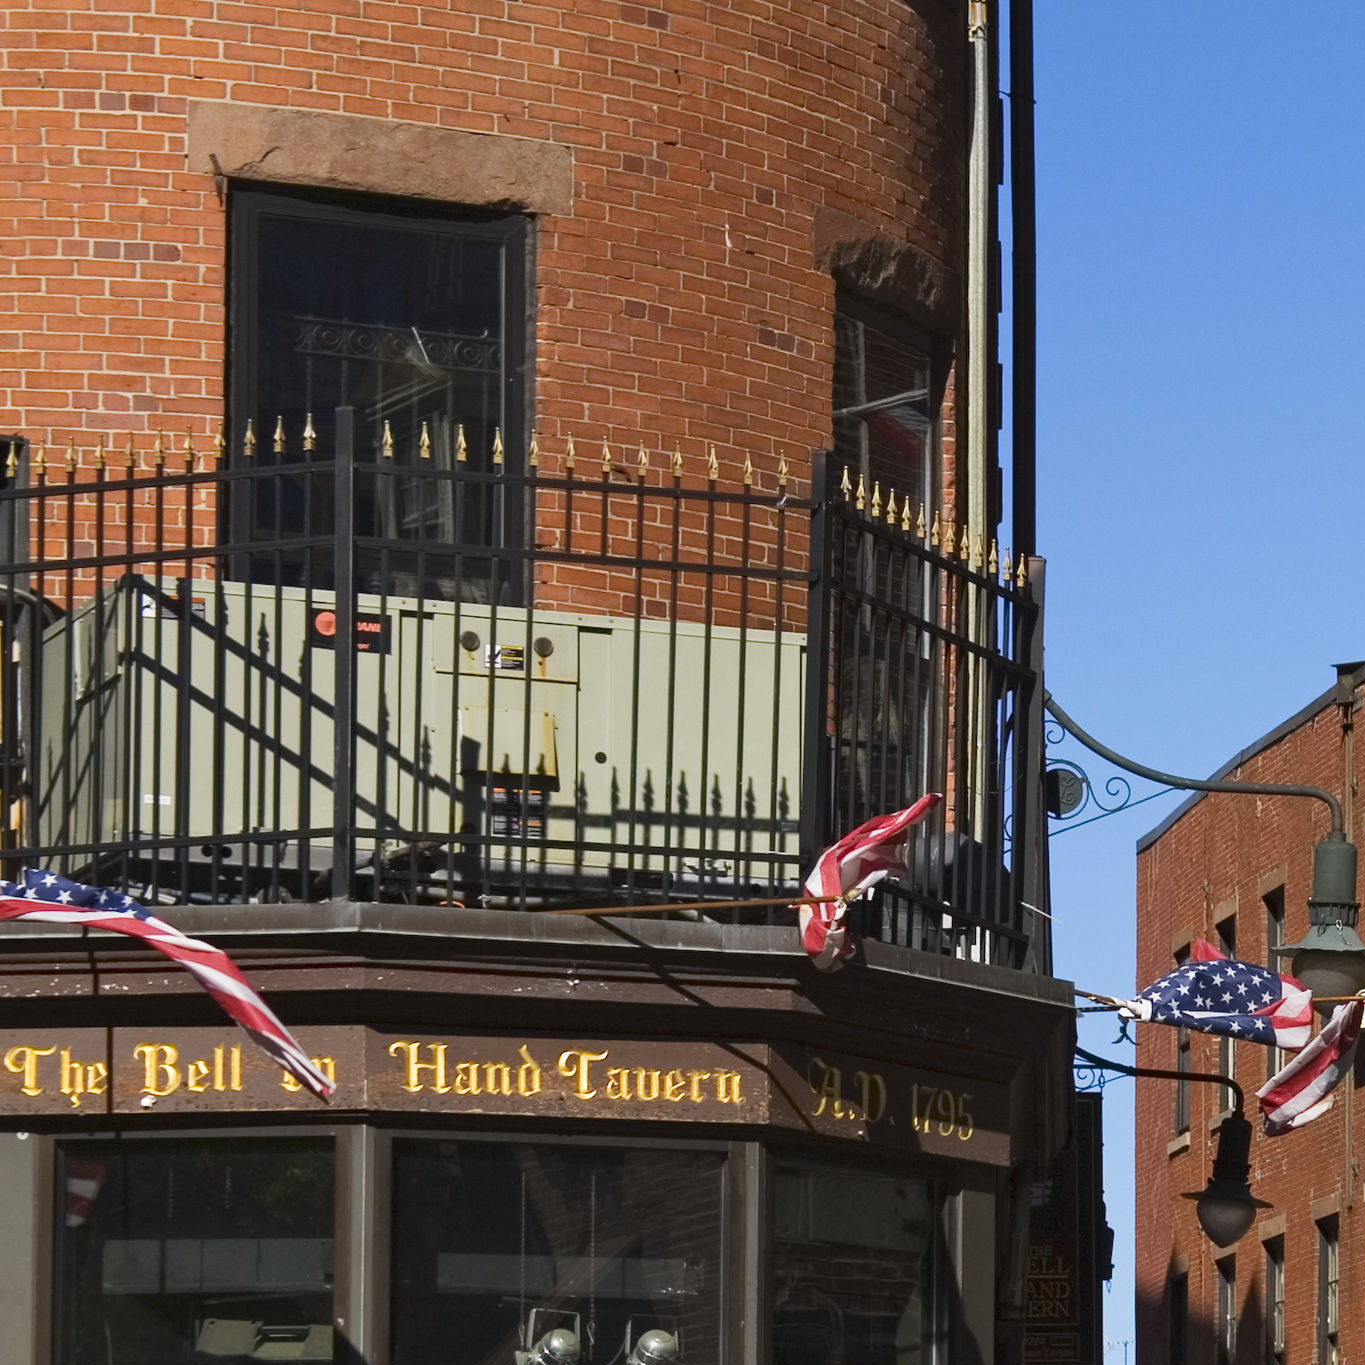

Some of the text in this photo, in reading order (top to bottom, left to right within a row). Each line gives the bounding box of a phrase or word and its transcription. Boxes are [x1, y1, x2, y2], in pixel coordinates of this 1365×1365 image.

[3, 1043, 109, 1109] The
[133, 1042, 243, 1097] Bell
[389, 1040, 542, 1097] Hand
[557, 1049, 744, 1104] Tavern
[808, 1057, 974, 1140] A.D. 1795
[1028, 1257, 1071, 1274] ELL
[1027, 1281, 1071, 1298] AND
